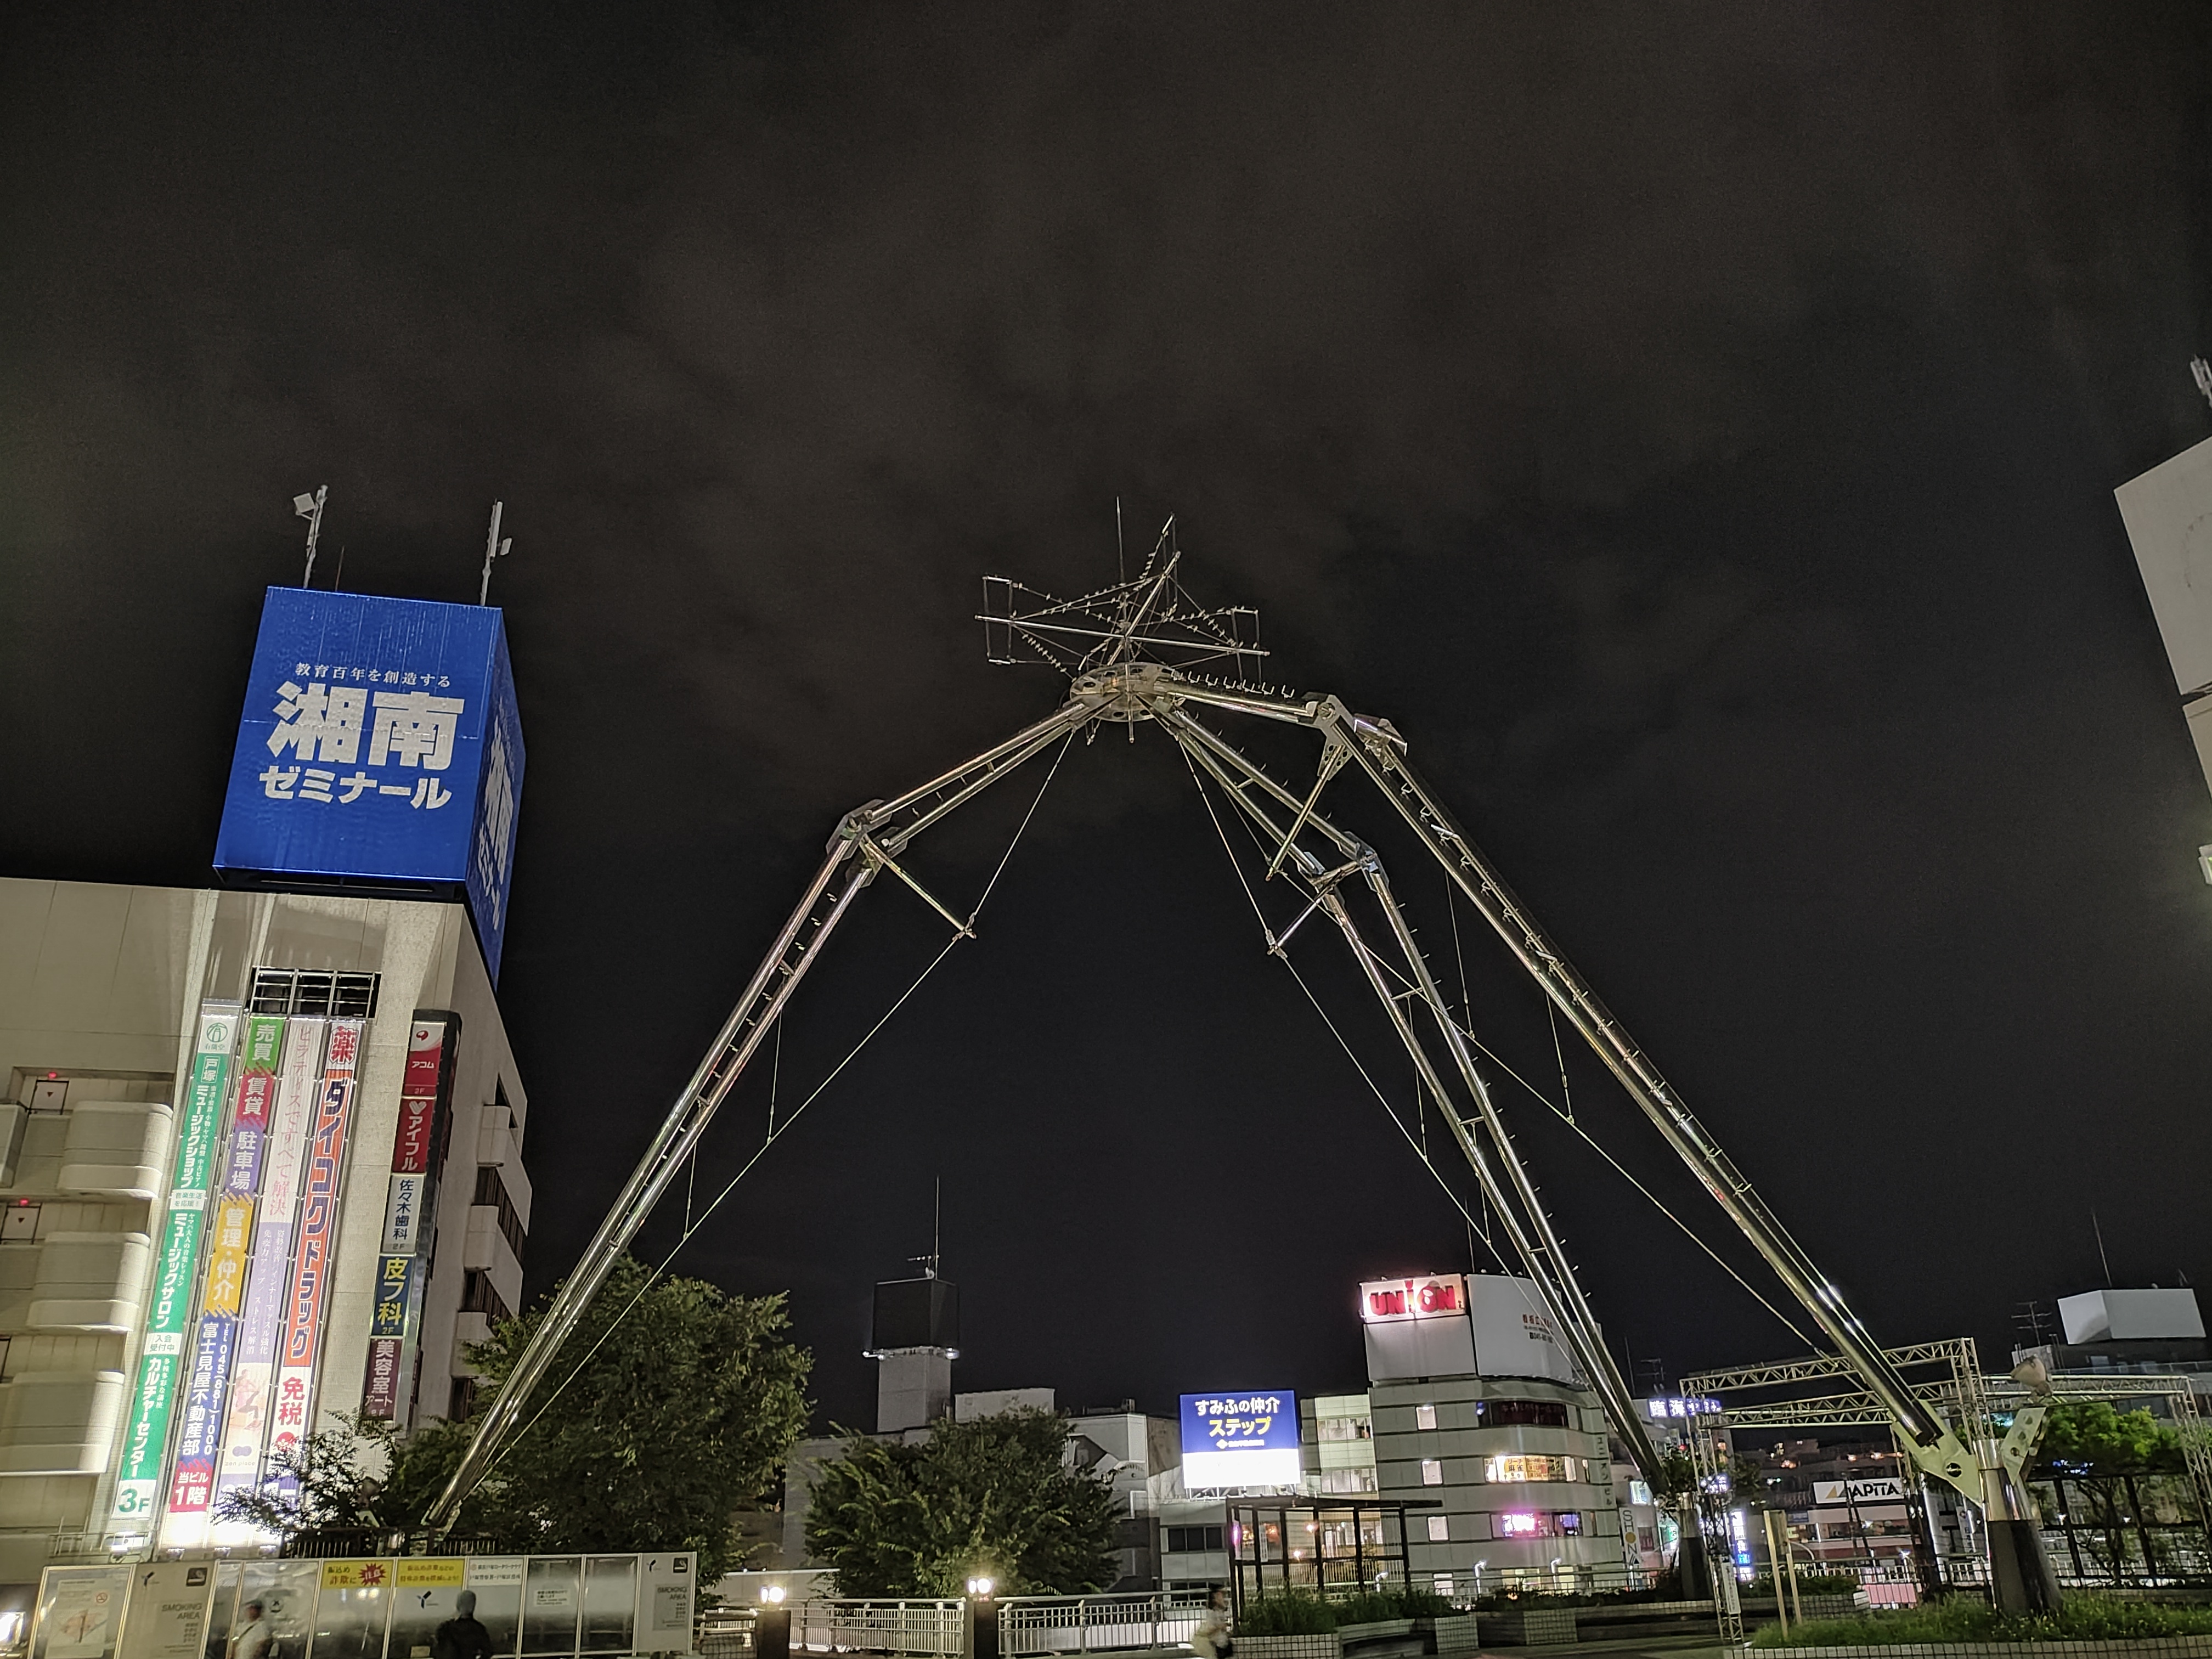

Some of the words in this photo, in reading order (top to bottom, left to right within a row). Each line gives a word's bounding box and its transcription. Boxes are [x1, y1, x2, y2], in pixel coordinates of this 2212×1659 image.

[295, 662, 450, 687] 教育百年を創造する
[266, 681, 465, 770] 湘南
[259, 766, 452, 809] ゼミナール
[252, 1024, 276, 1061] 売買
[330, 1025, 359, 1064] 薬
[204, 1058, 218, 1081] 戸塚
[242, 1077, 267, 1115] 賃貸
[181, 1085, 210, 1188] ミュージックショップ
[402, 1116, 422, 1171] アイフル
[230, 1131, 257, 1190] 駐車場
[291, 1078, 350, 1359] ダイコクドラッグ
[392, 1180, 414, 1240] 佐々木歯科
[178, 1213, 196, 1286] ヤマハ大人の音楽レッスン
[213, 1207, 245, 1301] 管理・仲介
[156, 1213, 188, 1329] ミュージックサロン
[377, 1257, 408, 1326] 皮フ科
[150, 1343, 175, 1352] 受付中
[371, 1340, 395, 1394] 美容室
[182, 1322, 219, 1455] 富士見屋不動産部
[278, 1376, 305, 1426] 免税
[365, 1395, 393, 1407] アート
[1195, 1397, 1280, 1416] すみふの仲介
[130, 1357, 162, 1477] カルチャーセンター
[1209, 1416, 1272, 1437] ステップ
[175, 1486, 207, 1505] 1階
[178, 1471, 208, 1483] 当ビル
[1851, 1482, 1900, 1497] APITA
[118, 1488, 150, 1513] 3F
[162, 1602, 202, 1612] SMOKING
[177, 1611, 200, 1620] AREA
